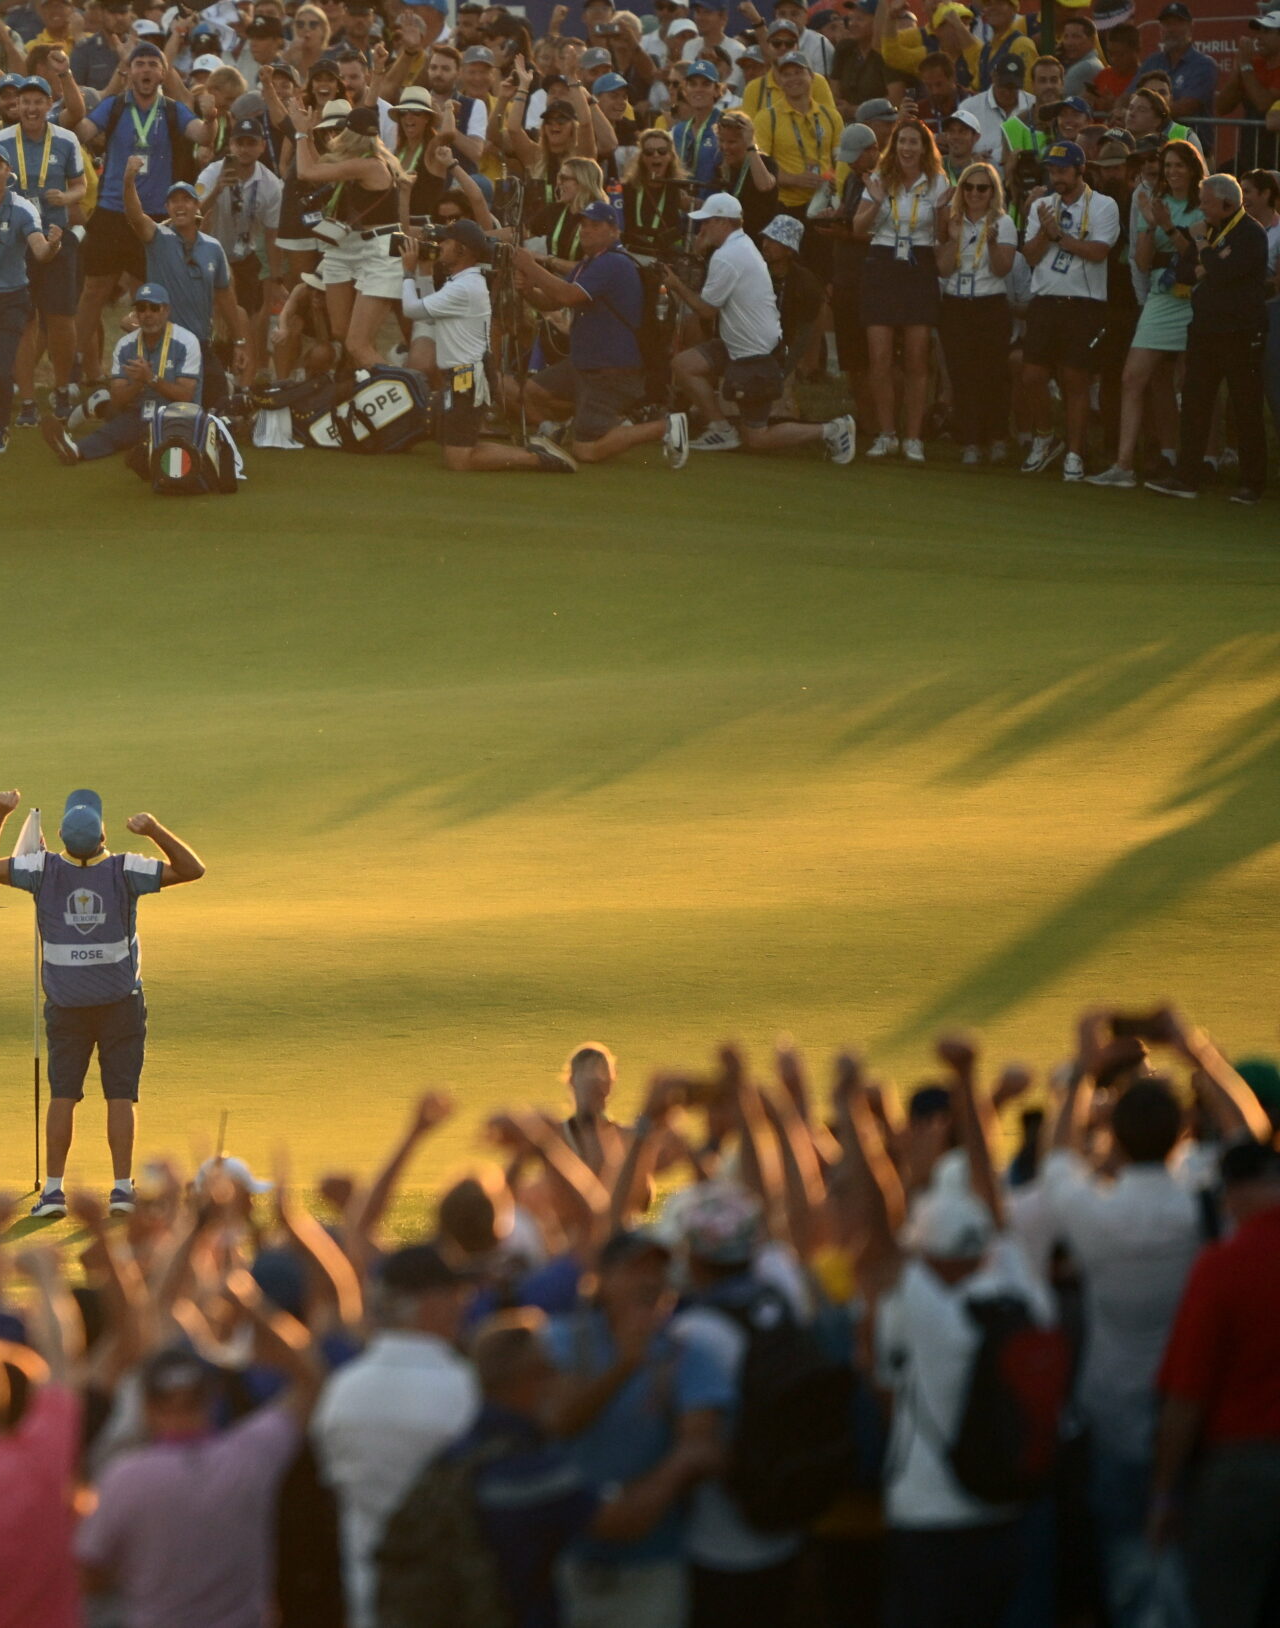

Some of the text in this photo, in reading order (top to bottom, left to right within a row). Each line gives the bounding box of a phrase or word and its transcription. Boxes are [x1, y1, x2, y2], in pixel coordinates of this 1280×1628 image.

[1194, 39, 1239, 53] THRILL
[325, 387, 403, 444] EOPE
[70, 949, 104, 960] ROSE
